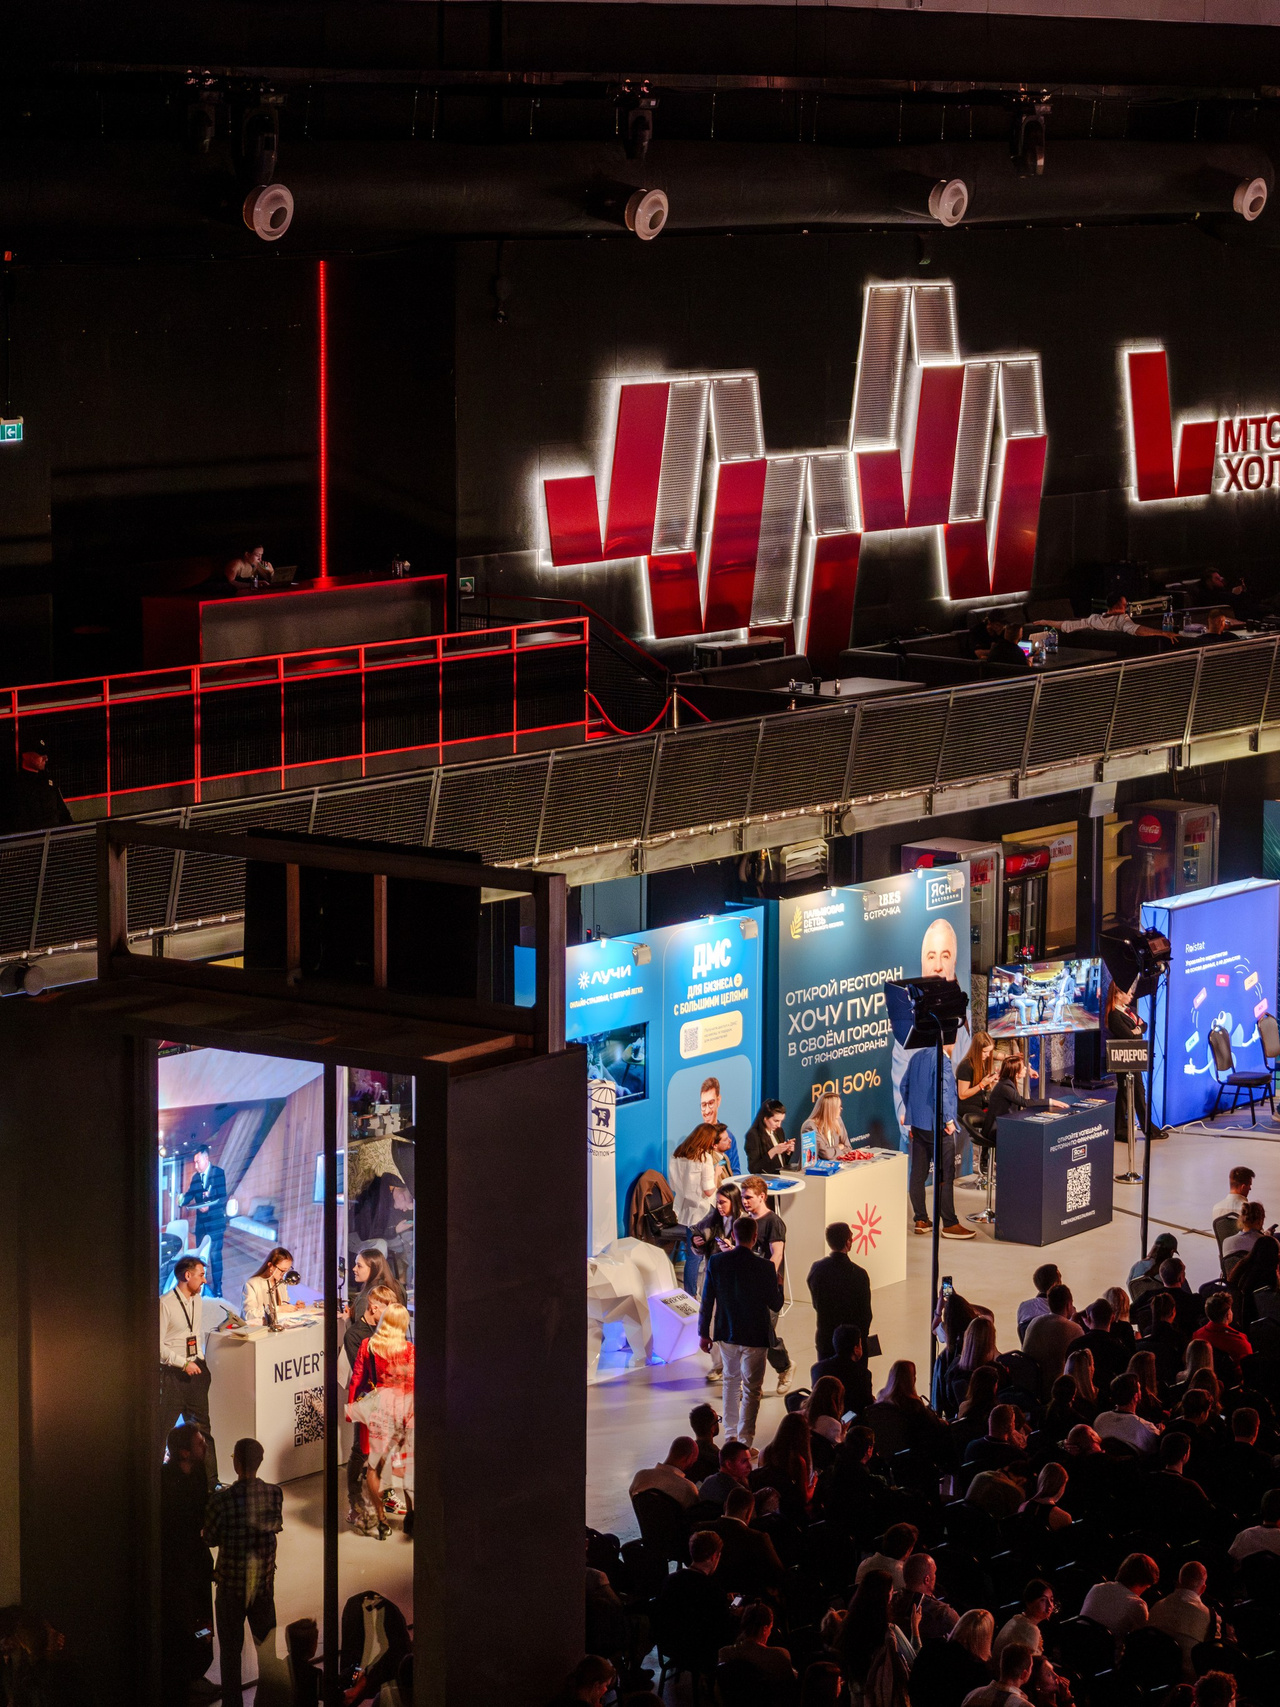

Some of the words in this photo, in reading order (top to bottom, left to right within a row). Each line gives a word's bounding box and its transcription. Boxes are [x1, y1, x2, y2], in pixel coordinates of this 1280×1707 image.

[863, 912, 869, 921] 5
[870, 906, 901, 919] СТРОЧКА
[692, 938, 732, 980] ДМС
[687, 983, 702, 1000] ДЛЯ
[703, 976, 734, 994] БИЗНЕСА
[785, 978, 838, 1007] ОТКРОЙ
[839, 965, 904, 994] РЕСТОРАН
[673, 1004, 679, 1016] С
[680, 994, 720, 1015] БОЛЬШИМИ
[720, 987, 749, 1007] ЦЕЛЯМИ
[788, 1001, 843, 1036] ХОЧУ
[788, 1042, 797, 1056] В
[799, 1029, 845, 1054] СВОЁМ
[801, 1055, 813, 1067] ОТ
[814, 1036, 888, 1064] ЯСНОРЕСТОРАНЫ
[1110, 1048, 1148, 1063] ГАРДЕРОБ
[842, 1068, 881, 1095] 50%
